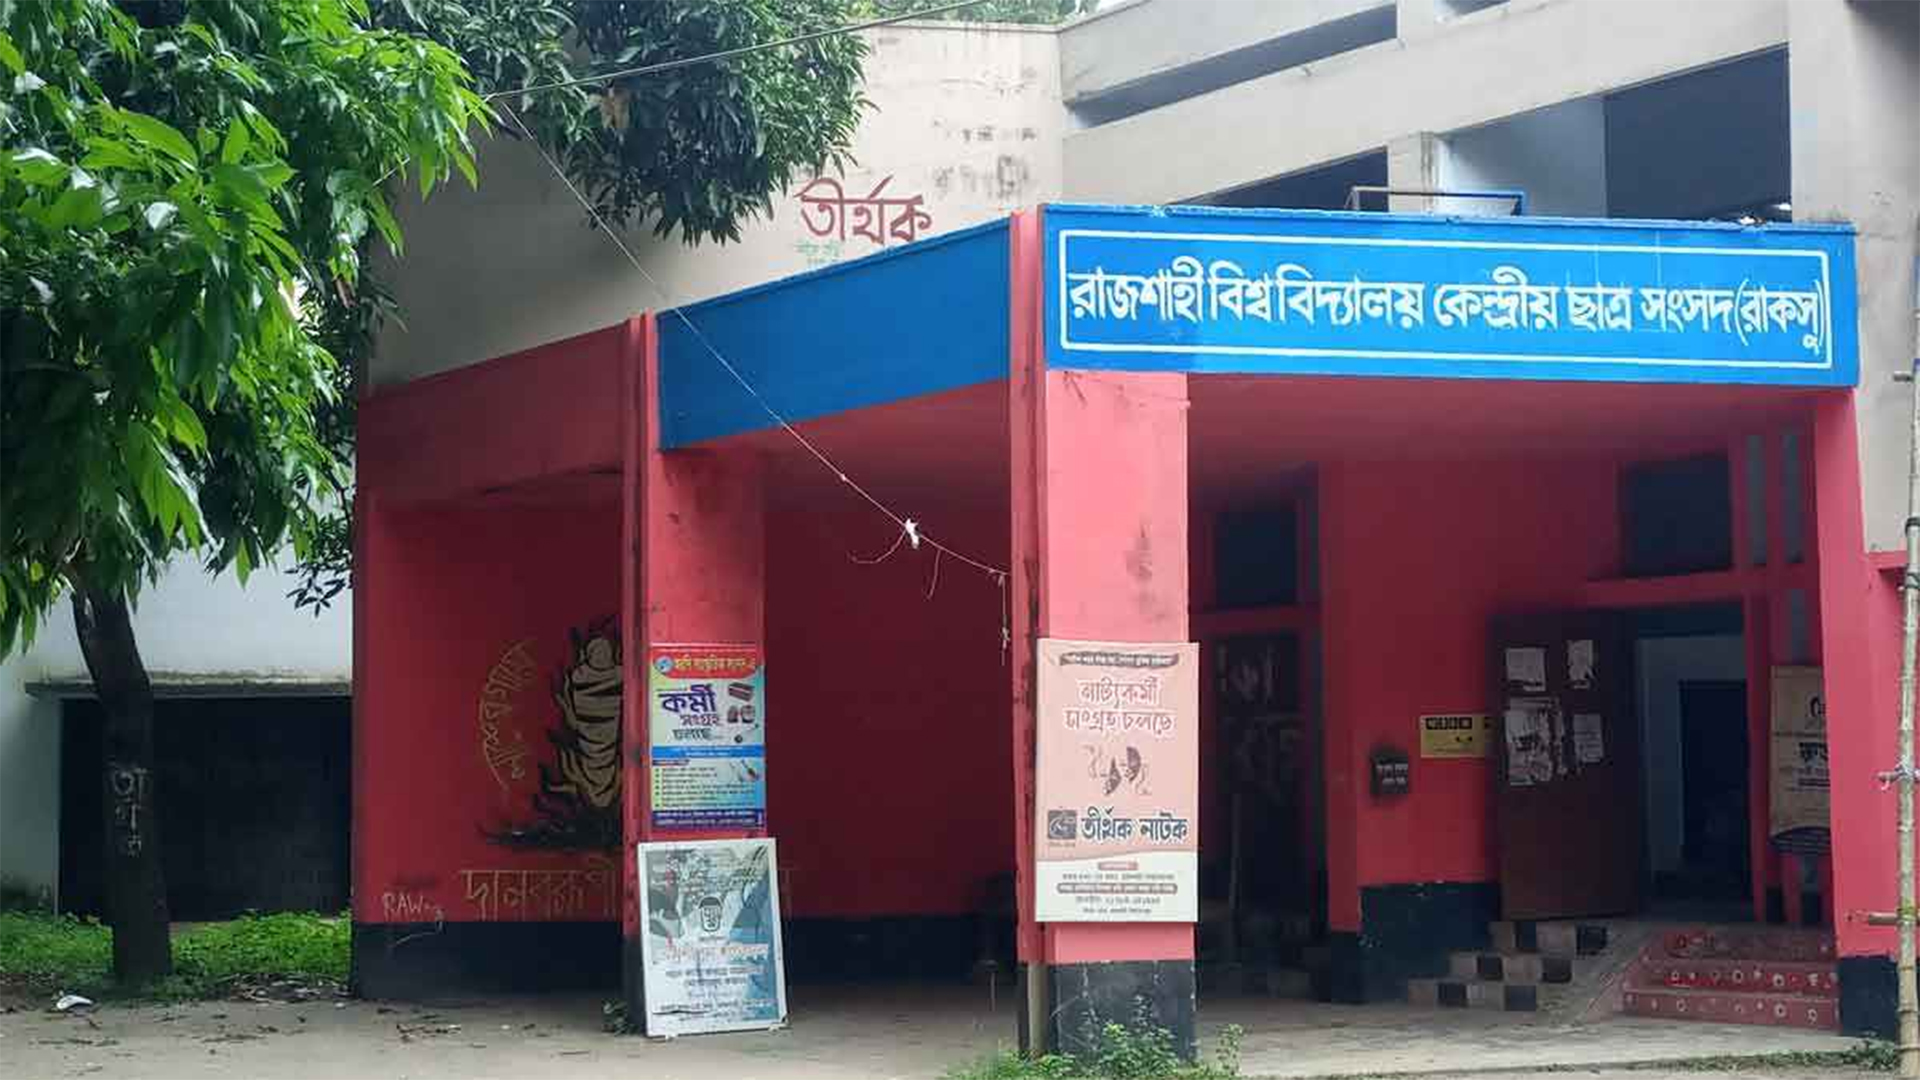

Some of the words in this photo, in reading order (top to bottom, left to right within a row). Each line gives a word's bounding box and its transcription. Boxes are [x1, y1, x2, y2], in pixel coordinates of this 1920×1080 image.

[793, 175, 932, 244] তীর্থক
[1068, 256, 1204, 323] রাজশাহী
[1433, 265, 1558, 330] কেন্দ্রীয়
[1566, 281, 1633, 333] ছাত্র
[657, 683, 716, 714] কর্মী
[1080, 806, 1133, 841] তীর্থক
[1138, 812, 1188, 841] নাটক
